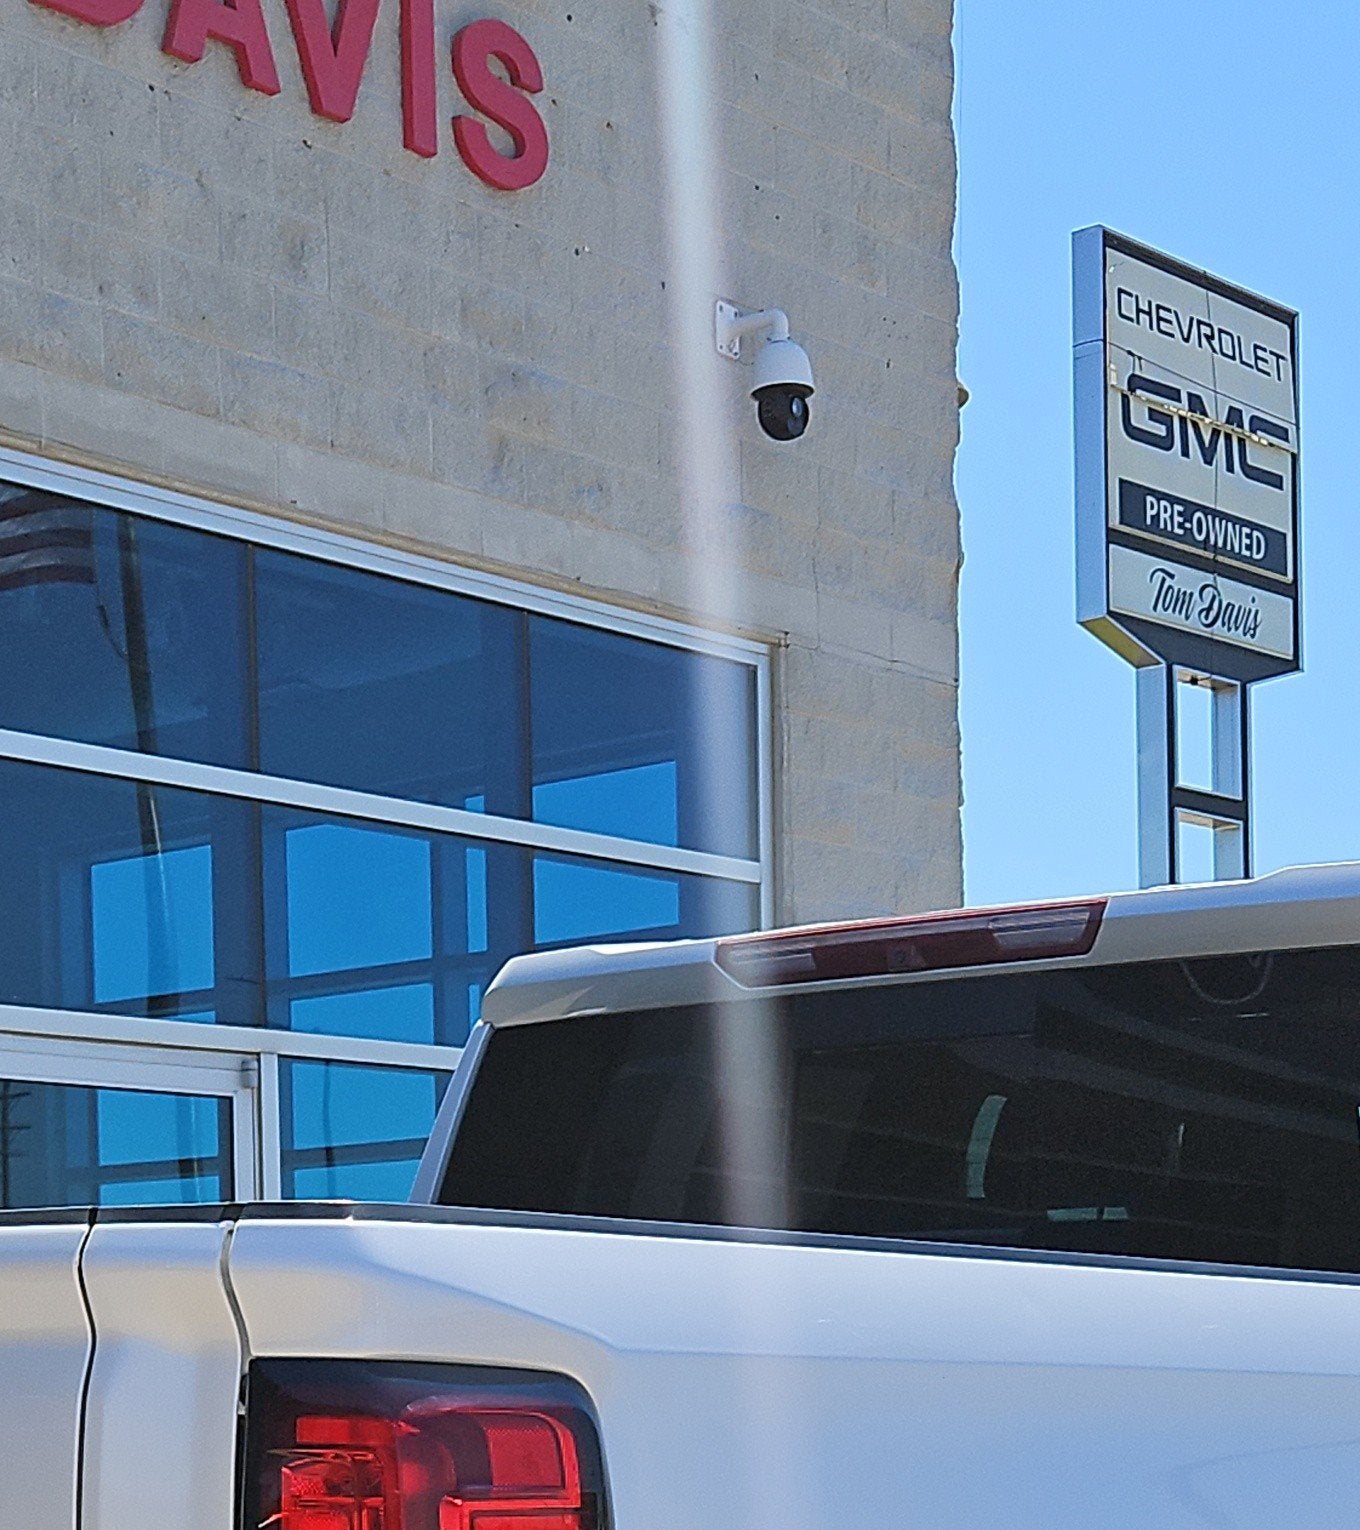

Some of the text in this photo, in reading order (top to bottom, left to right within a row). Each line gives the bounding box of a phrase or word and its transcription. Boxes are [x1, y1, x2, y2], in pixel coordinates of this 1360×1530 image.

[1116, 286, 1288, 383] CHEVROLET
[1121, 373, 1290, 491] GMC
[1145, 494, 1267, 562] PRE-OWNED
[1148, 566, 1262, 640] Tom Davis
